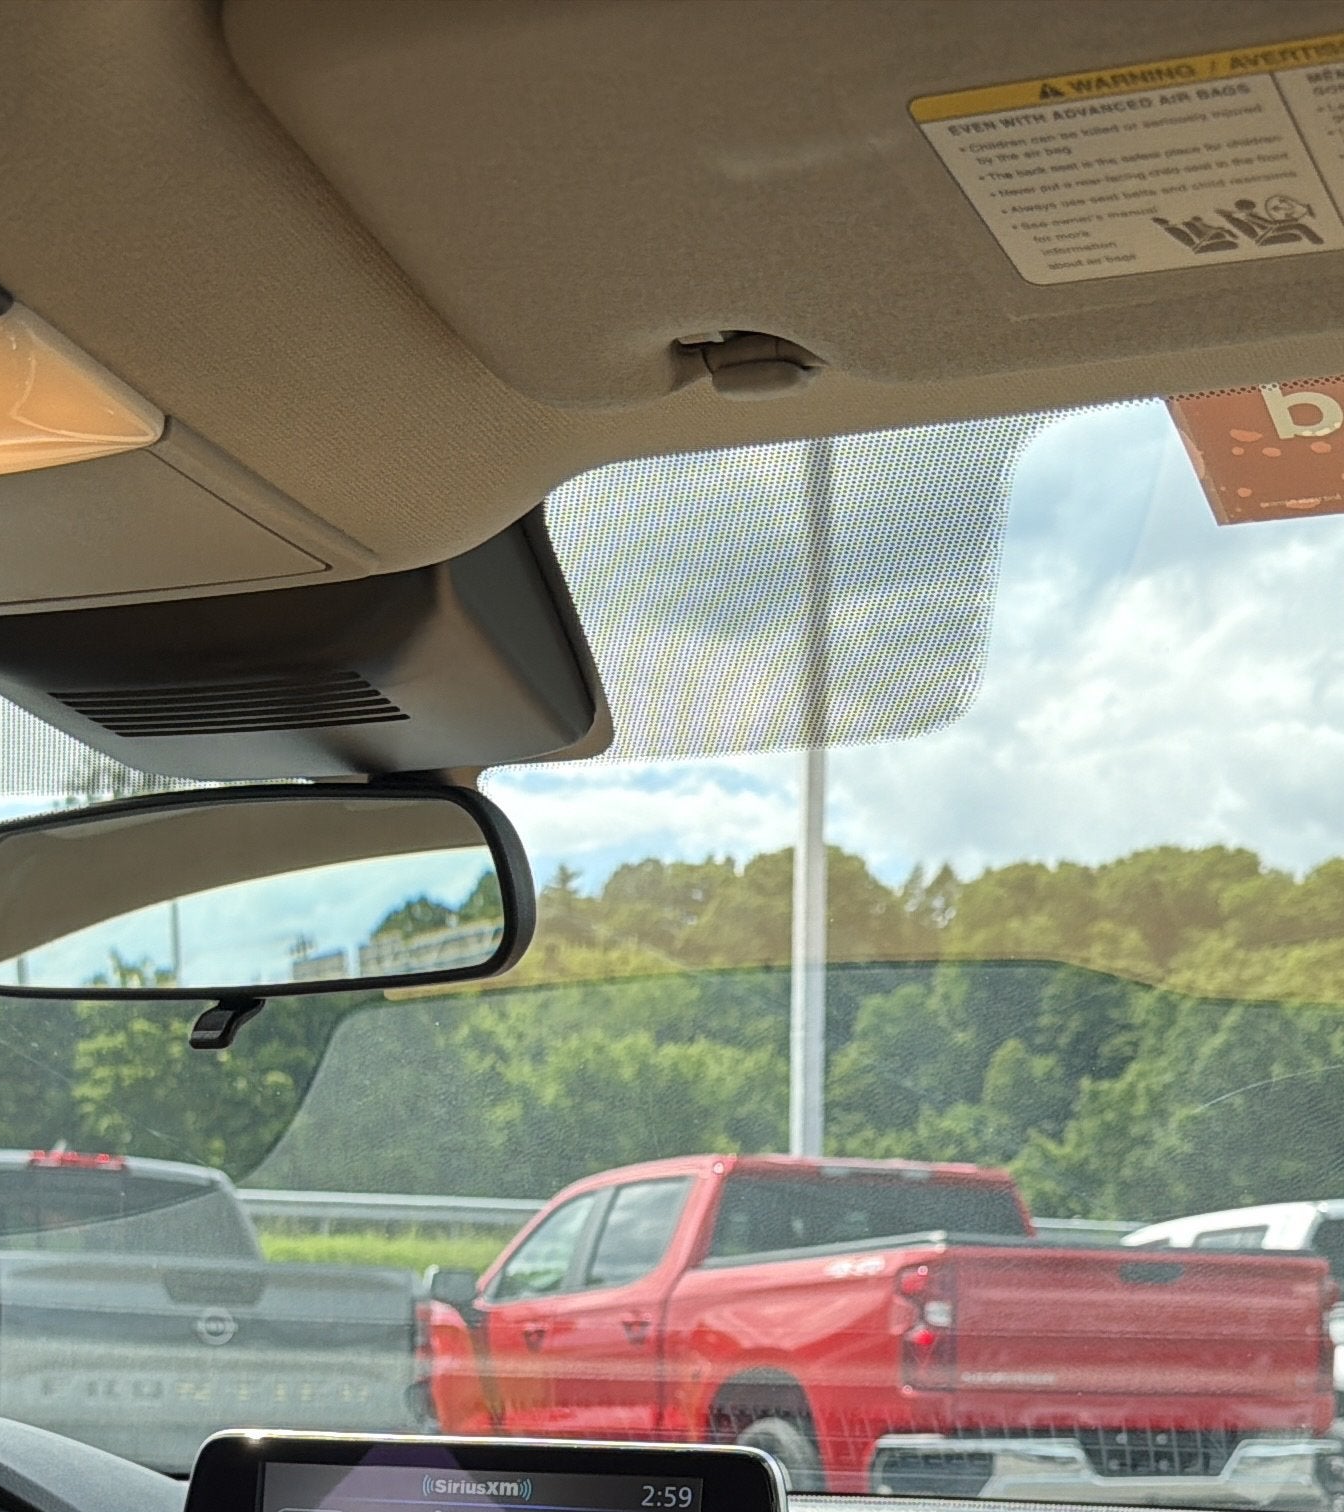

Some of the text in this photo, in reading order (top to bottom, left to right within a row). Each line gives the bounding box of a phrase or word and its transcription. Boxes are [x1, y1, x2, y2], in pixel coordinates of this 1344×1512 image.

[1069, 64, 1196, 95] WARNING
[948, 85, 1250, 136] EVEN WITH ADVANCED AIR BAGS
[641, 1485, 692, 1508] 2:59
